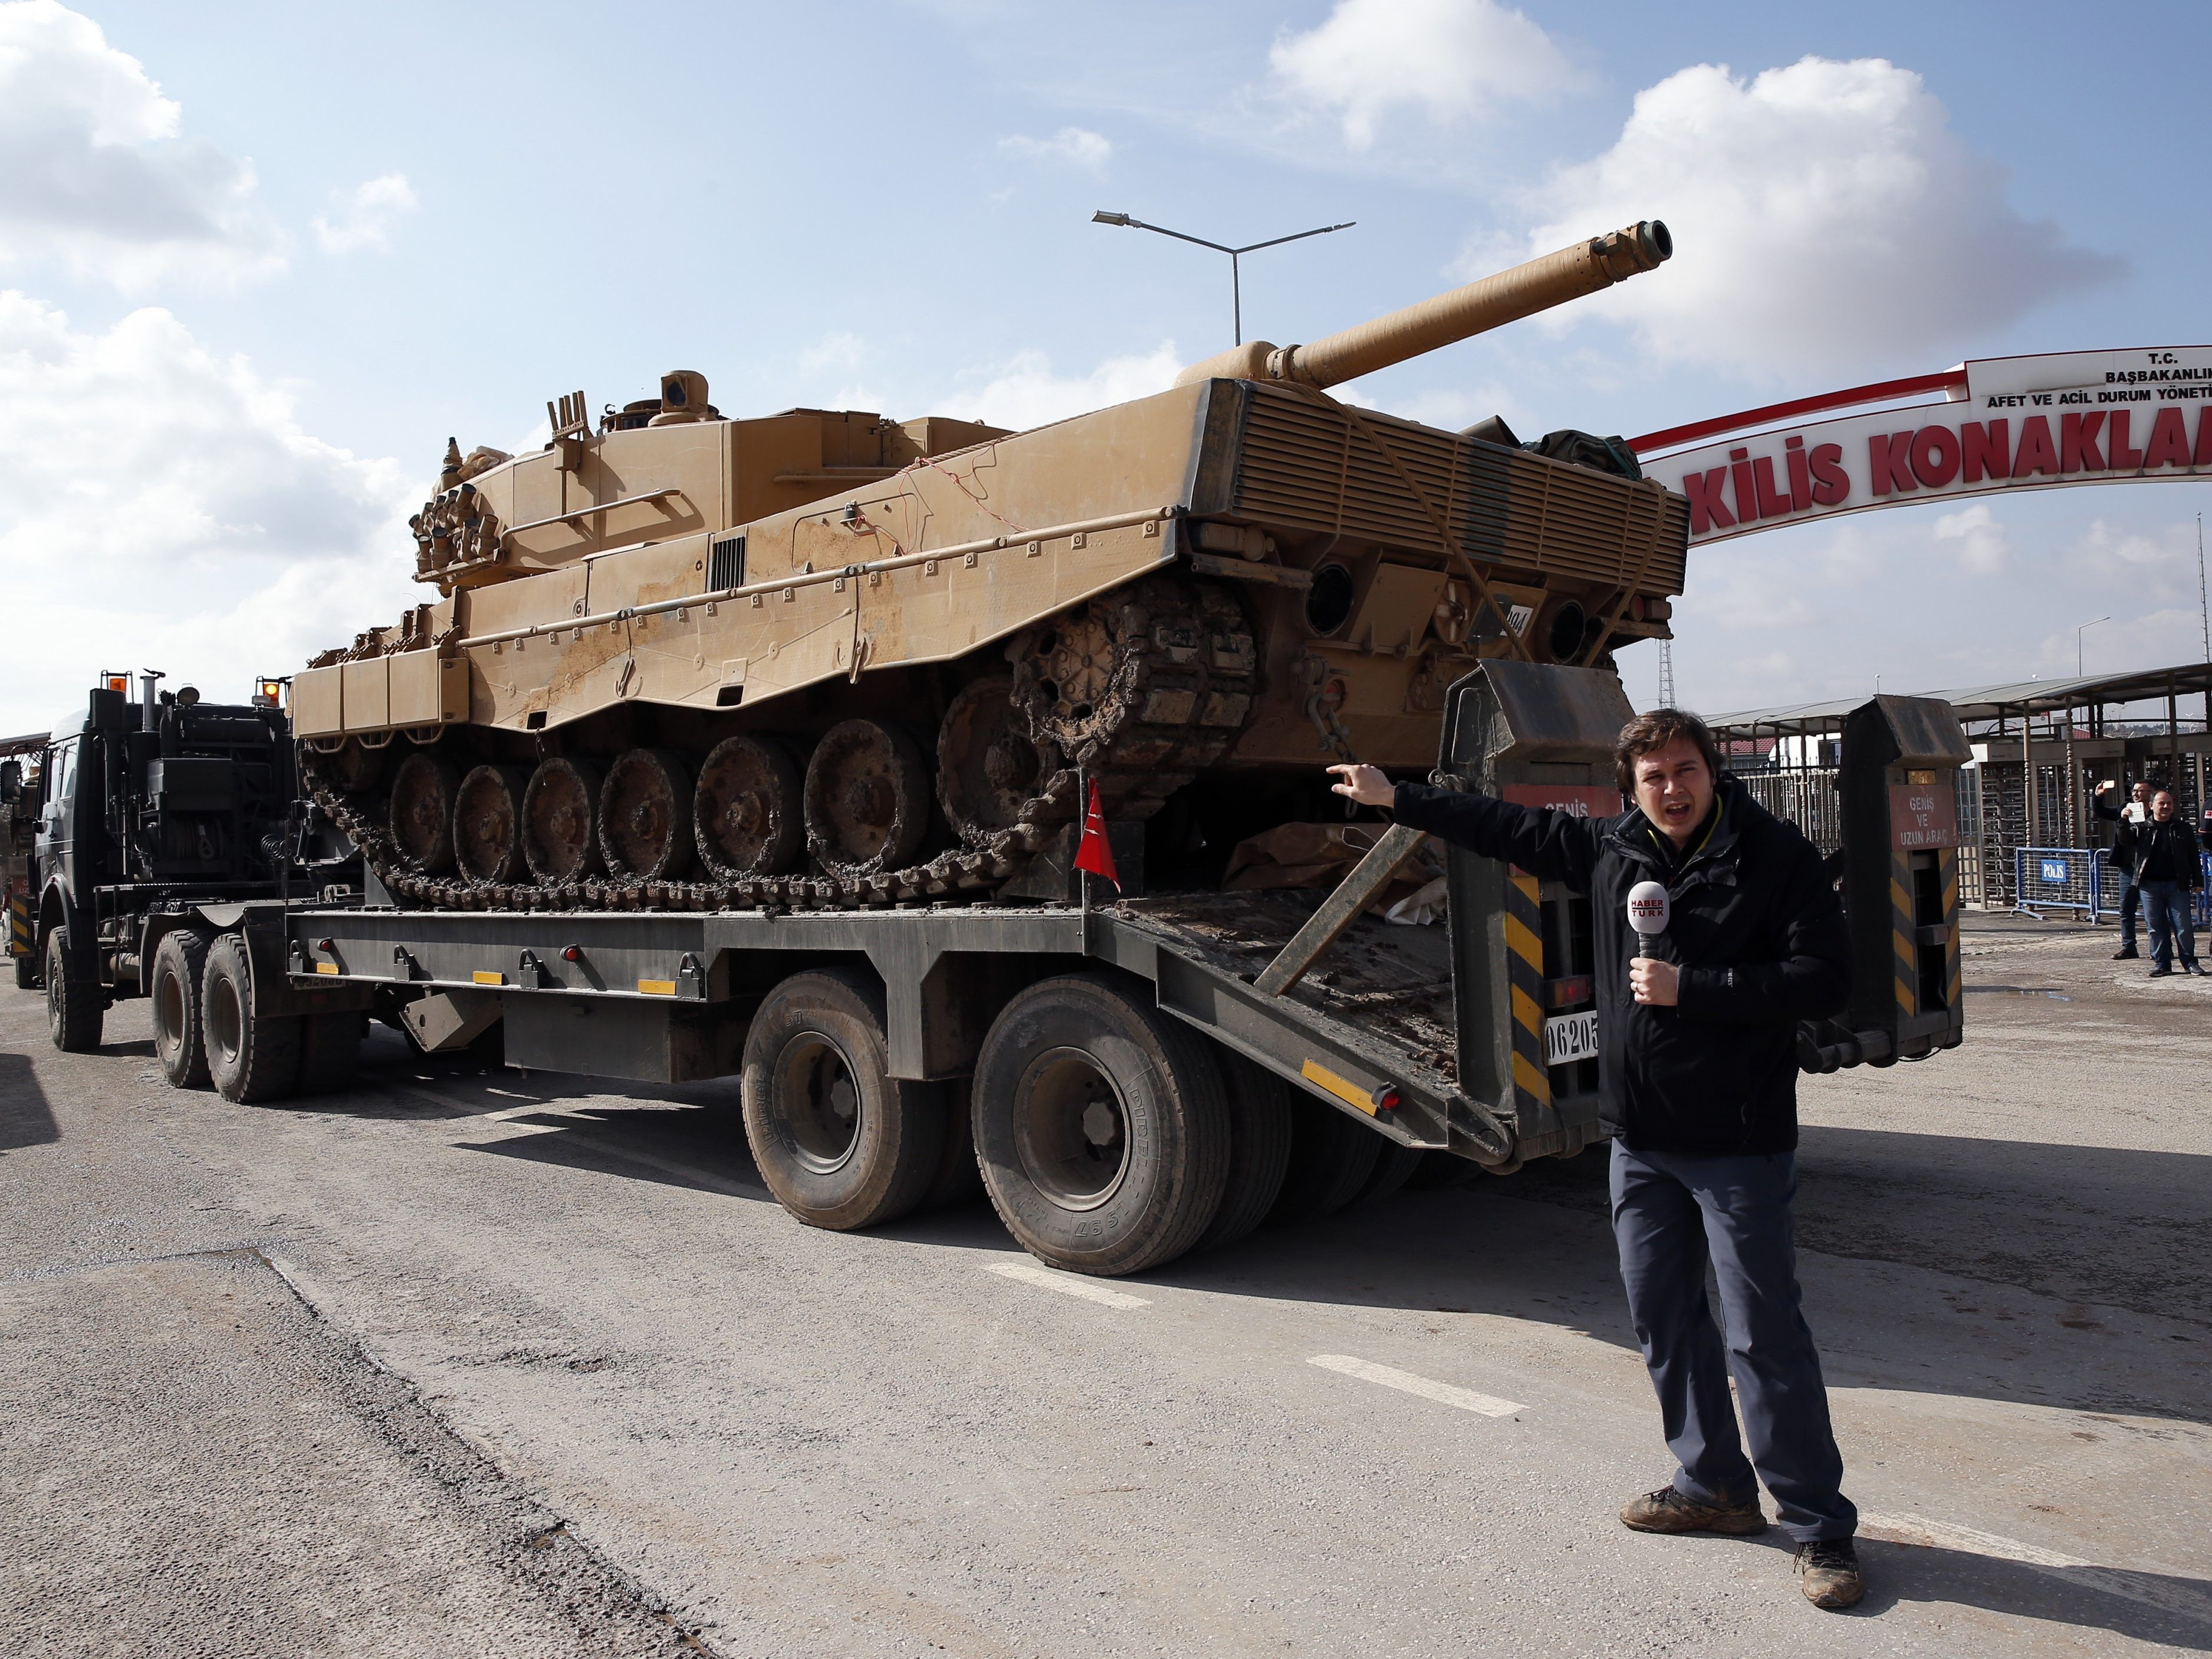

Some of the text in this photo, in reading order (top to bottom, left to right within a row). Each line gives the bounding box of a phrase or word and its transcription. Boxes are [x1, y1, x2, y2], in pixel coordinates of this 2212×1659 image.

[2148, 353, 2178, 364] T.C.
[1987, 395, 2026, 408] AFET
[2032, 394, 2052, 405] VE
[2059, 389, 2092, 404] ACİL
[2098, 389, 2151, 403] DURUM
[1683, 435, 1850, 536] KİLİS
[1910, 794, 1934, 812] GENİŞ
[1917, 814, 1928, 827] VE
[1901, 829, 1947, 845] UZUN ARAÇ
[2043, 862, 2063, 879] POLİS
